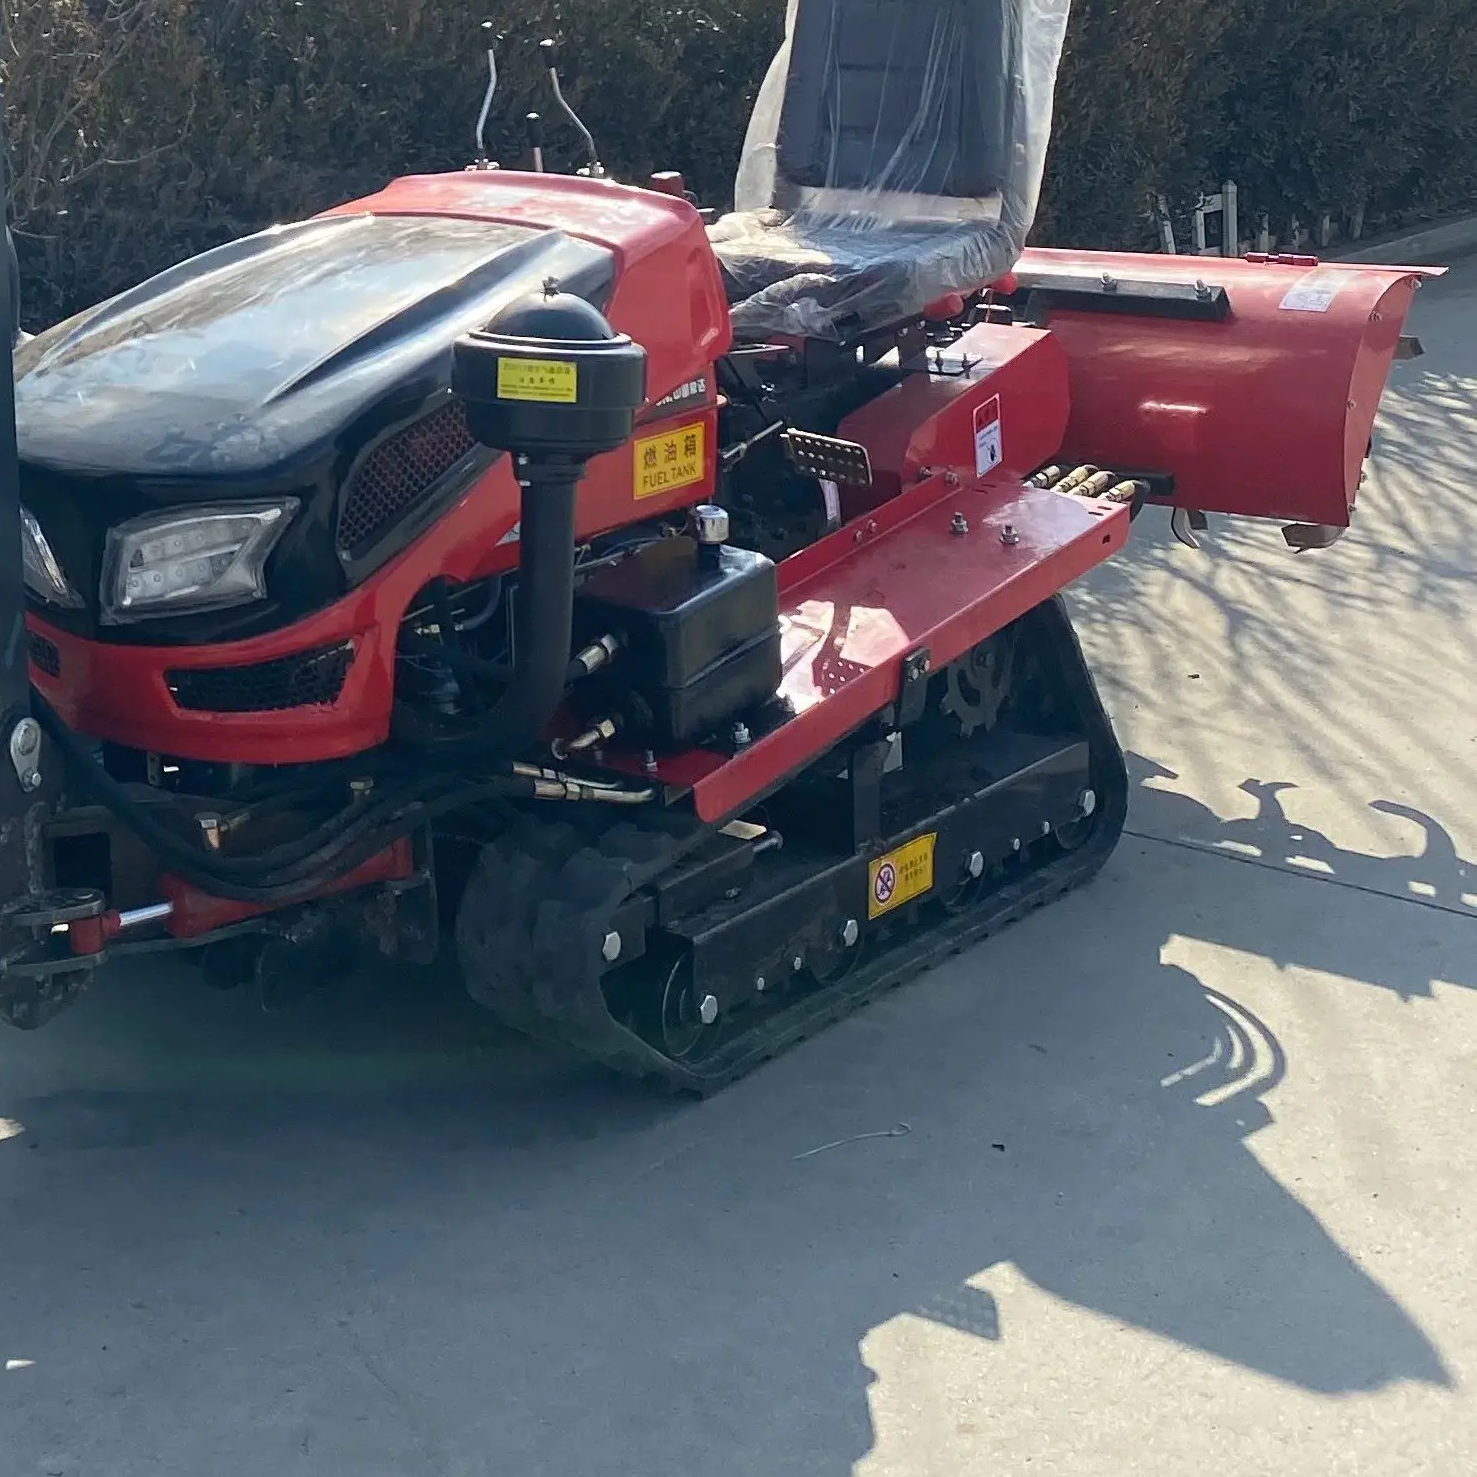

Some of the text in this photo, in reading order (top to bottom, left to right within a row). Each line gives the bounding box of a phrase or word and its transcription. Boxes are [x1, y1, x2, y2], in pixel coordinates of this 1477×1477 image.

[644, 434, 696, 470] 燃油箱
[643, 462, 696, 488] FUEL TANK
